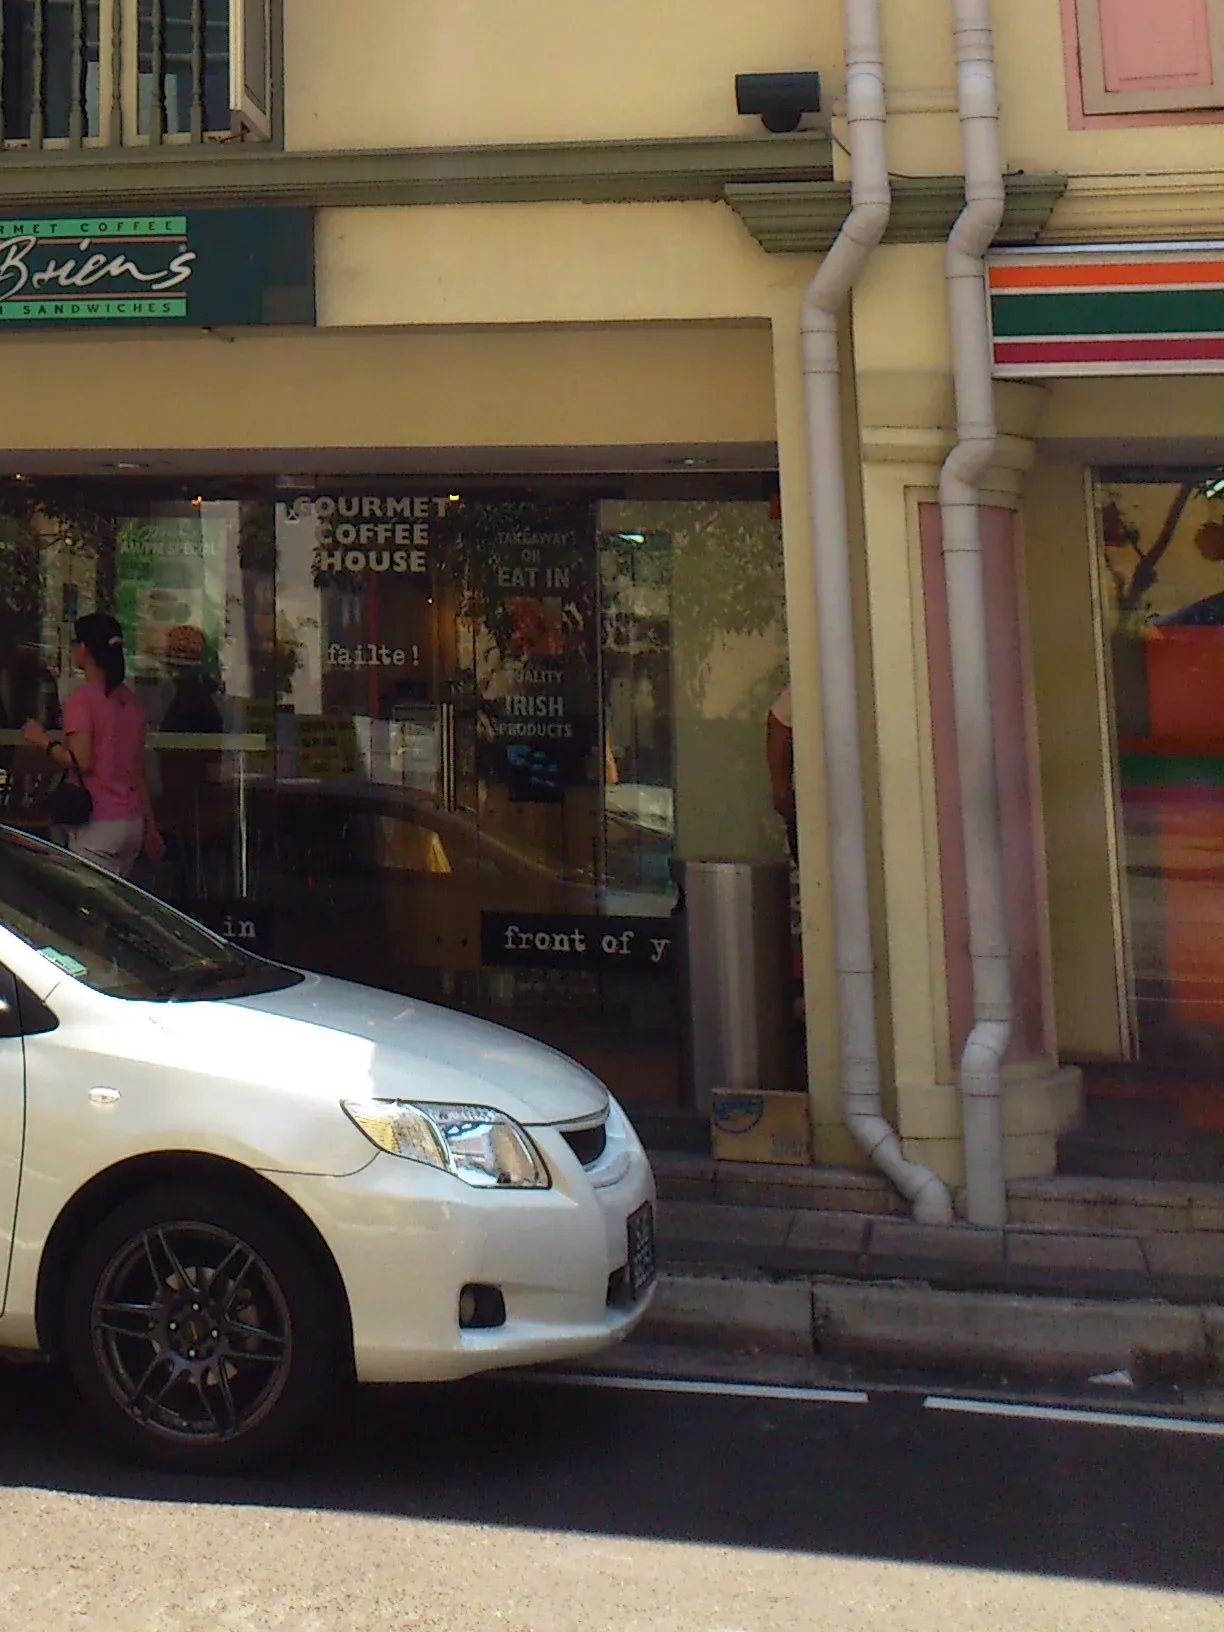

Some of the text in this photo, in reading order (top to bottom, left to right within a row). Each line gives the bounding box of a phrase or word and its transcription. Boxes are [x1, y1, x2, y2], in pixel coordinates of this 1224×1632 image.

[79, 220, 173, 233] COFFEE
[22, 301, 172, 315] SANDWICHES
[293, 496, 449, 518] GOURMET
[315, 523, 429, 545] COFFEE
[320, 550, 426, 572] HOUSE
[497, 567, 570, 587] EAT IN
[507, 669, 563, 683] UALITY
[506, 695, 564, 717] IRISH
[498, 722, 572, 738] PRODUCTS
[223, 915, 256, 937] in
[504, 925, 586, 953] front
[602, 931, 634, 954] of
